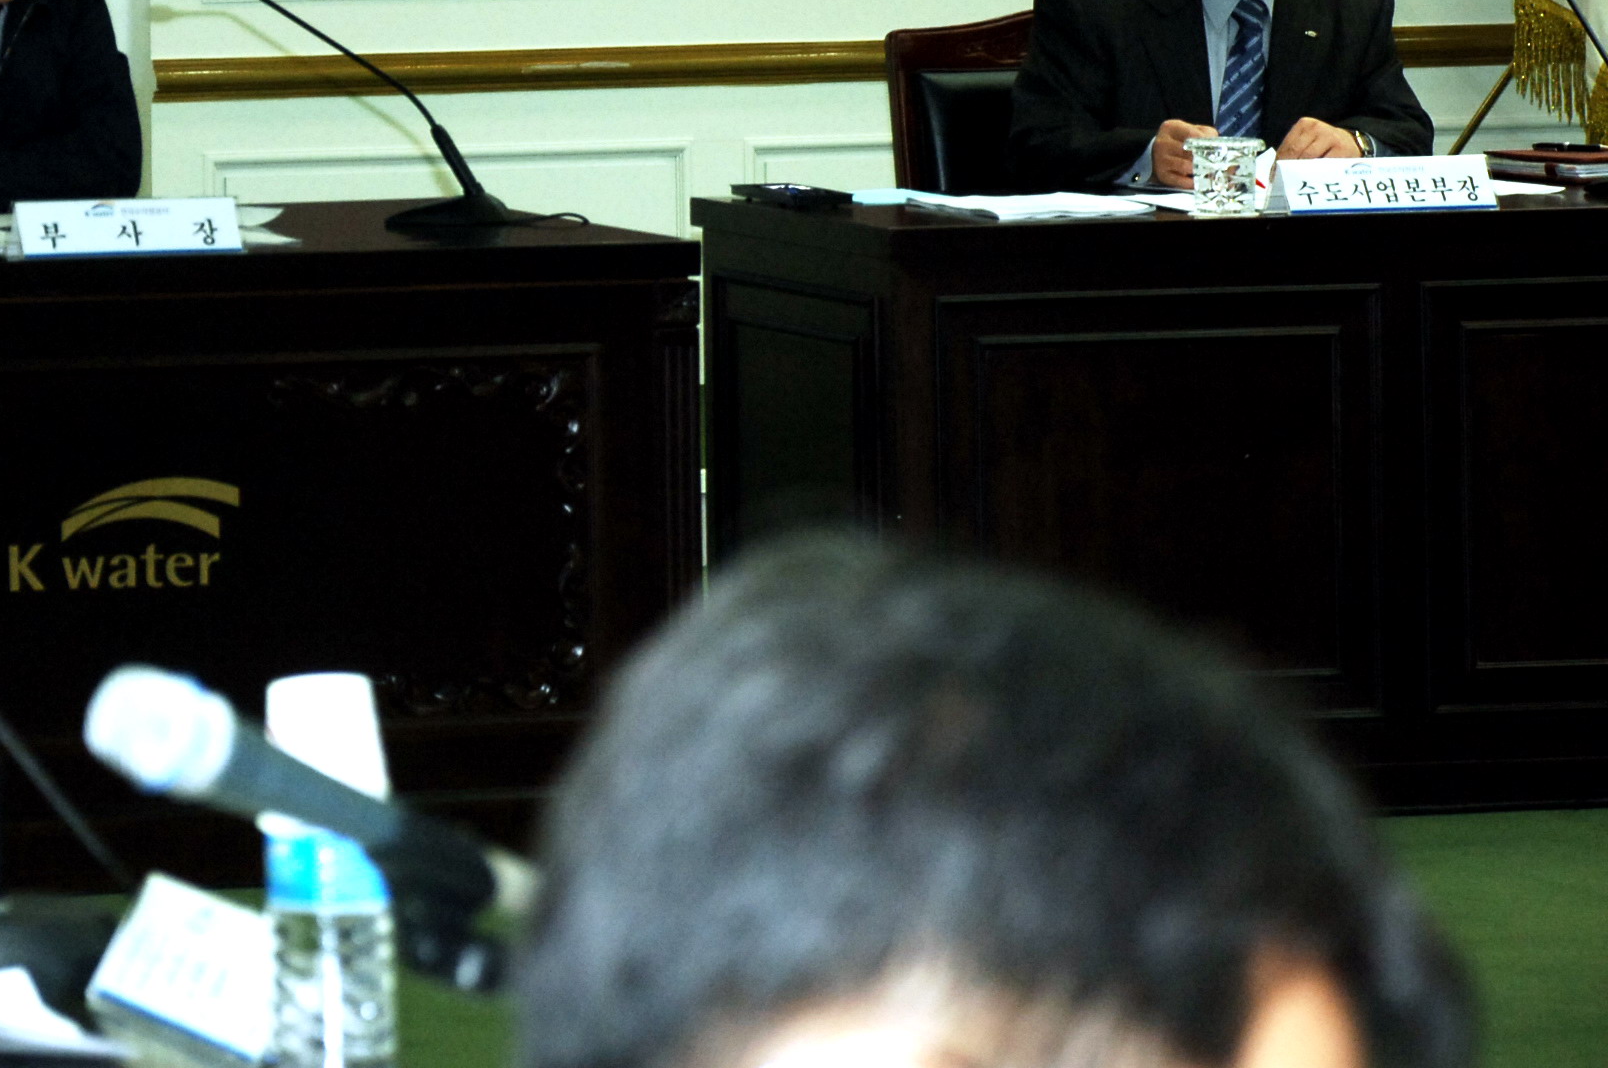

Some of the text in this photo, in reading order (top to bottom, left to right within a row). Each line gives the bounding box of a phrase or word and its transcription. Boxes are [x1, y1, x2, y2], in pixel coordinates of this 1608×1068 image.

[1297, 175, 1480, 205] 수도사업본부장
[9, 544, 220, 592] K water
